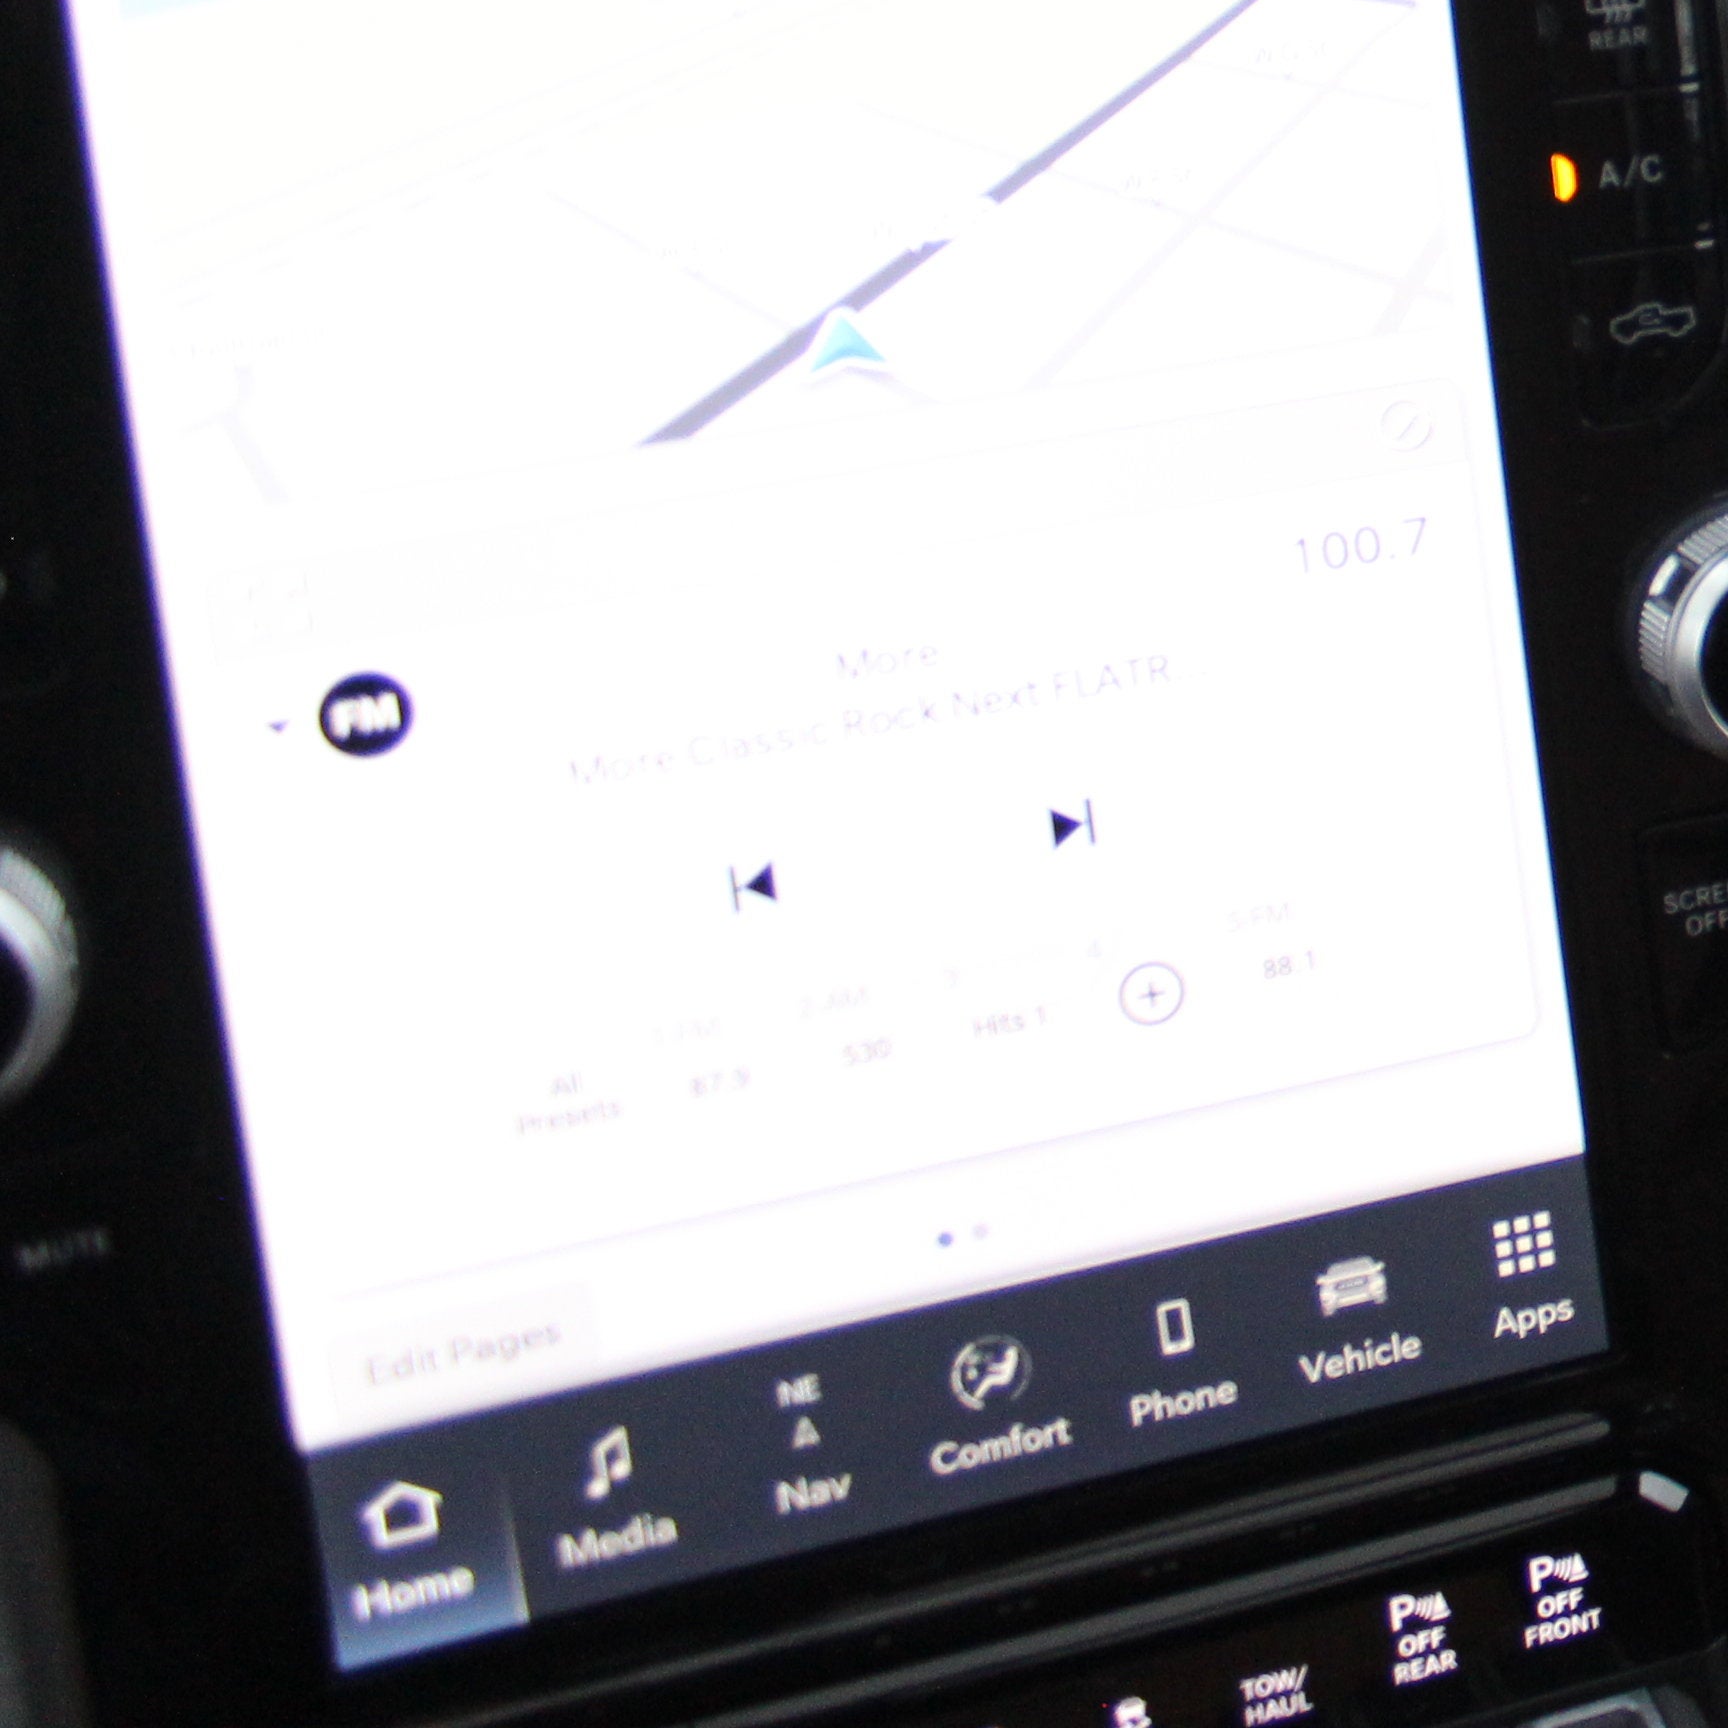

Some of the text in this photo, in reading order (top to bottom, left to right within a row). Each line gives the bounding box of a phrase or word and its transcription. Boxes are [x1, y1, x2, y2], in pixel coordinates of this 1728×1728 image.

[1588, 25, 1649, 51] REAR
[1599, 153, 1665, 190] A/C
[1295, 515, 1428, 574] 100.7
[837, 640, 940, 680] More
[331, 691, 402, 740] FM
[843, 694, 941, 740] Rock
[951, 677, 1041, 722] Next
[1494, 1295, 1575, 1340] Apps
[366, 1322, 564, 1387] Edit Pages
[1298, 1331, 1423, 1384] Vehicle
[776, 1372, 822, 1408] NE
[1129, 1380, 1239, 1428] Phone
[930, 1416, 1073, 1476] Comfort
[774, 1471, 852, 1516] Nav
[555, 1512, 679, 1569] Media
[350, 1565, 476, 1624] Home
[1536, 1587, 1585, 1619] OFF
[1396, 1626, 1447, 1659] OFF
[1523, 1606, 1603, 1650] FRONT
[1392, 1648, 1459, 1687] REAR
[1243, 1690, 1315, 1728] HAUL
